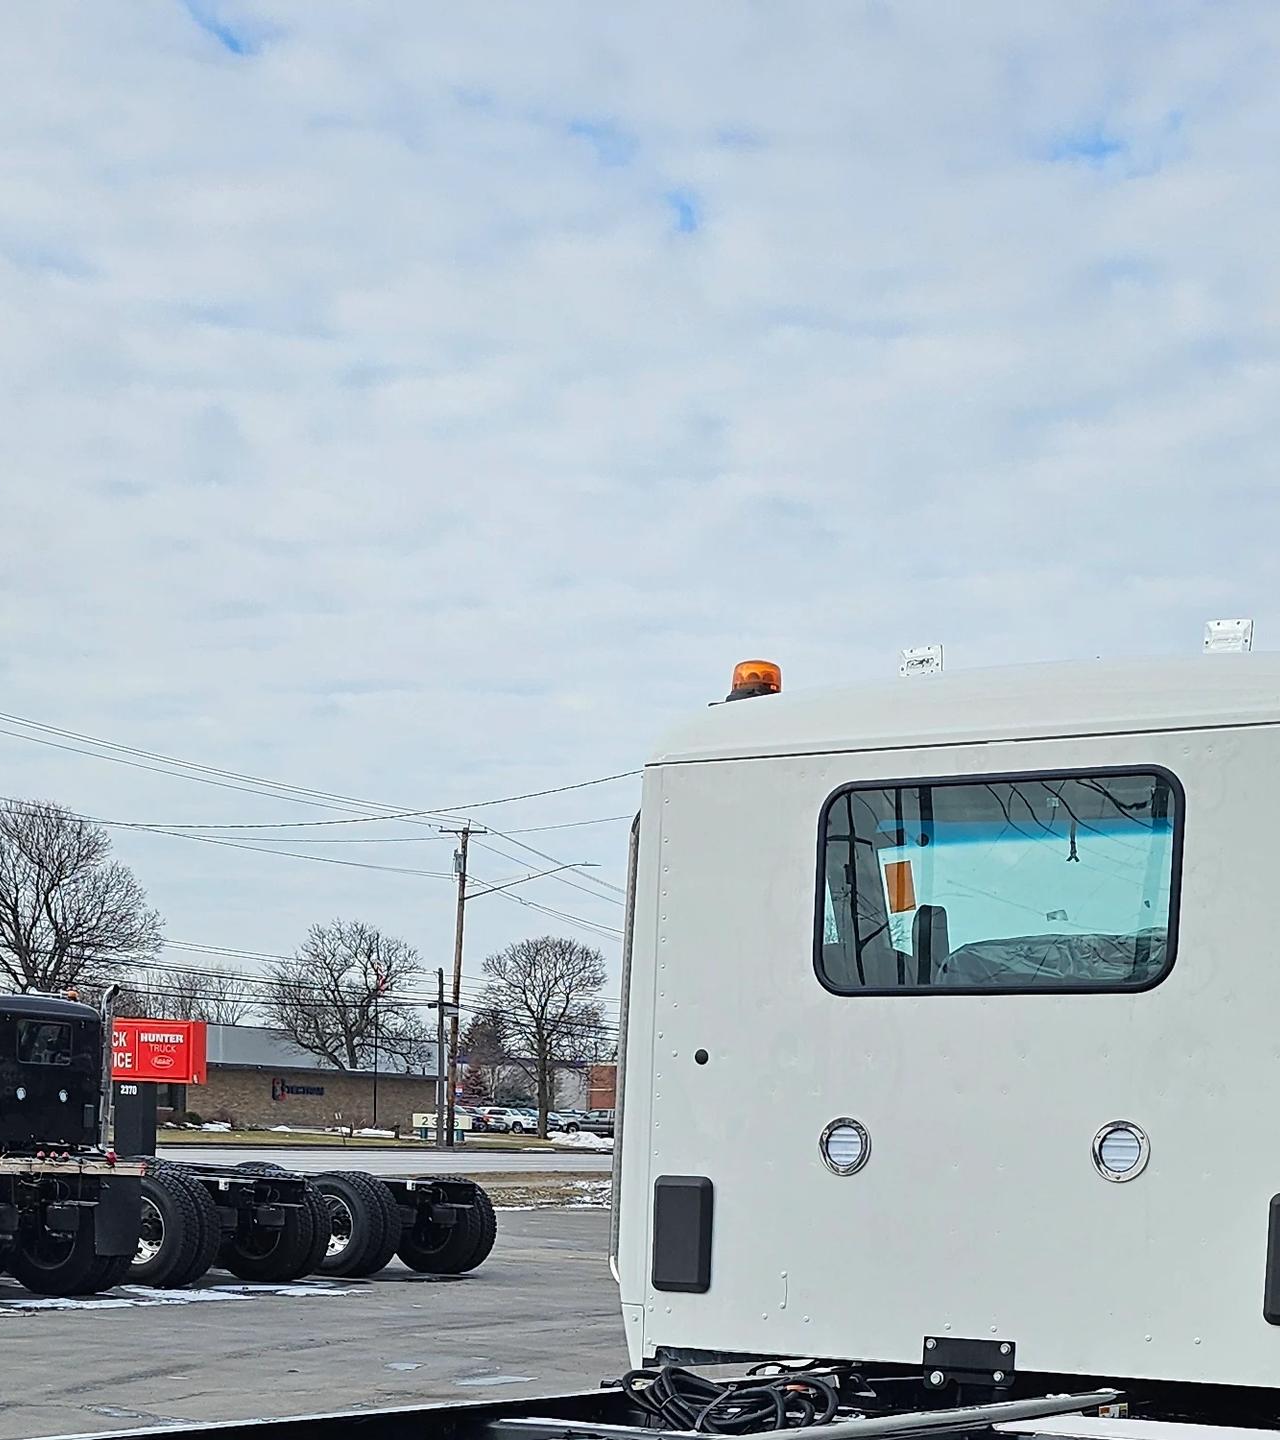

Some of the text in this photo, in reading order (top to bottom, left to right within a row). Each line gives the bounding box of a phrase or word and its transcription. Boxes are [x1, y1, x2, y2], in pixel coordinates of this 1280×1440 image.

[140, 1032, 184, 1043] HUNTER
[149, 1044, 177, 1053] TRUCK
[112, 1051, 133, 1069] ICE
[120, 1084, 138, 1095] 2370
